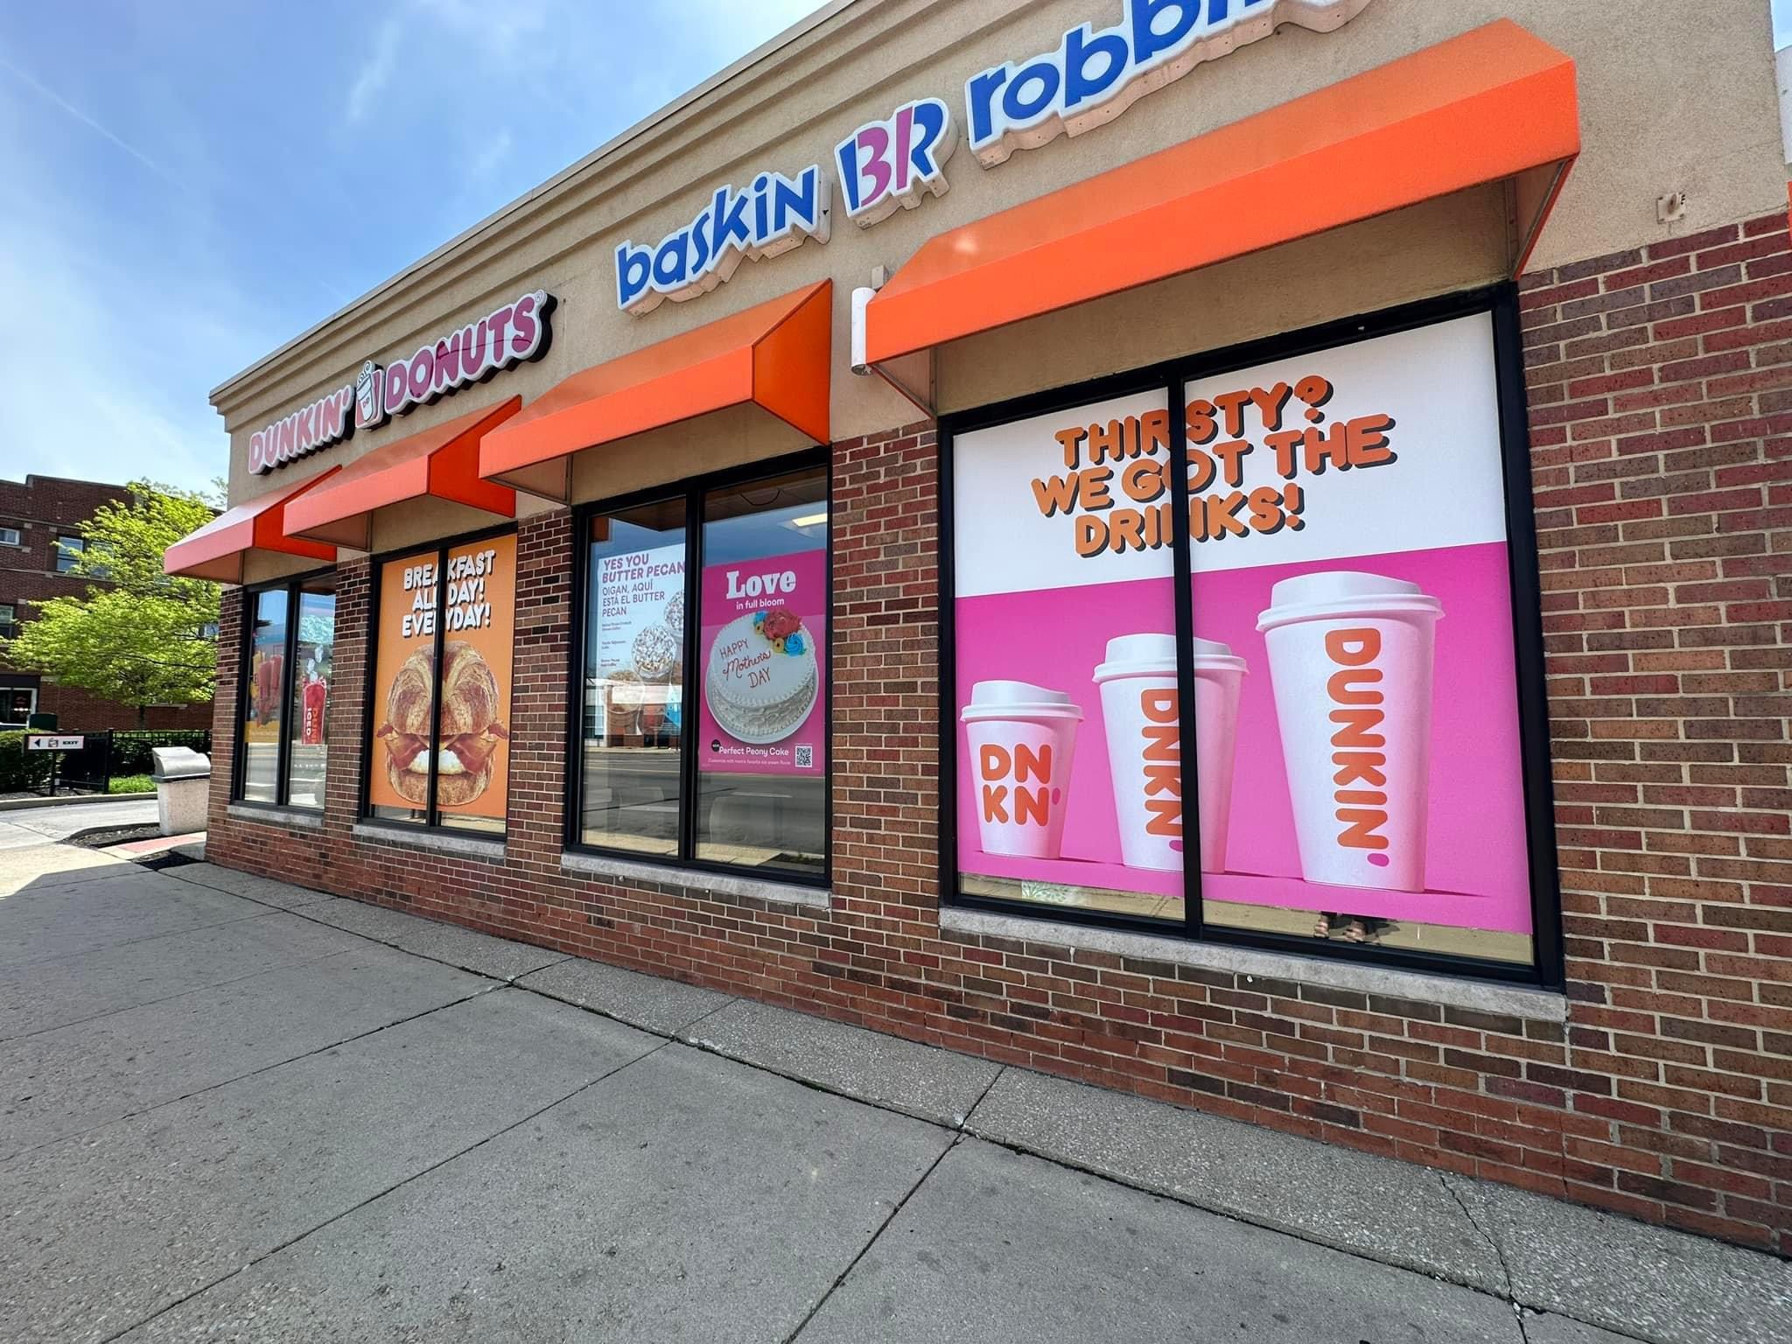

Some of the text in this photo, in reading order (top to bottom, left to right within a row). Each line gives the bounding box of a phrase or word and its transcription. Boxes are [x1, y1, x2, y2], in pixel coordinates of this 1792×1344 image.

[839, 102, 945, 212] BR
[969, 0, 1263, 143] robb
[249, 393, 350, 471] DUNKIN'
[385, 296, 537, 410] DONUTS
[1054, 375, 1334, 469] THIRSTY?
[1031, 413, 1398, 517] WE GOT THE
[1075, 483, 1306, 559] DRINKS!
[602, 561, 685, 584] BUTTER PECAN
[604, 553, 649, 571] YES YOU
[447, 578, 485, 607] DAY!
[621, 595, 631, 605] EL
[633, 591, 665, 604] BUTTER
[726, 570, 796, 599] Love
[401, 603, 491, 638] EVEYDAY!
[602, 606, 627, 618] PECAN
[736, 598, 785, 610] in full bloom
[719, 637, 749, 660] HAPPY
[748, 666, 771, 688] DAY
[311, 707, 319, 743] DUN
[719, 746, 744, 755] Perfect
[746, 747, 768, 758] Peony
[769, 747, 790, 756] Cake
[979, 743, 1052, 784] DN
[1325, 627, 1390, 868] DUNKIN'
[1140, 688, 1184, 853] DNKN'
[982, 784, 1062, 827] KN'
